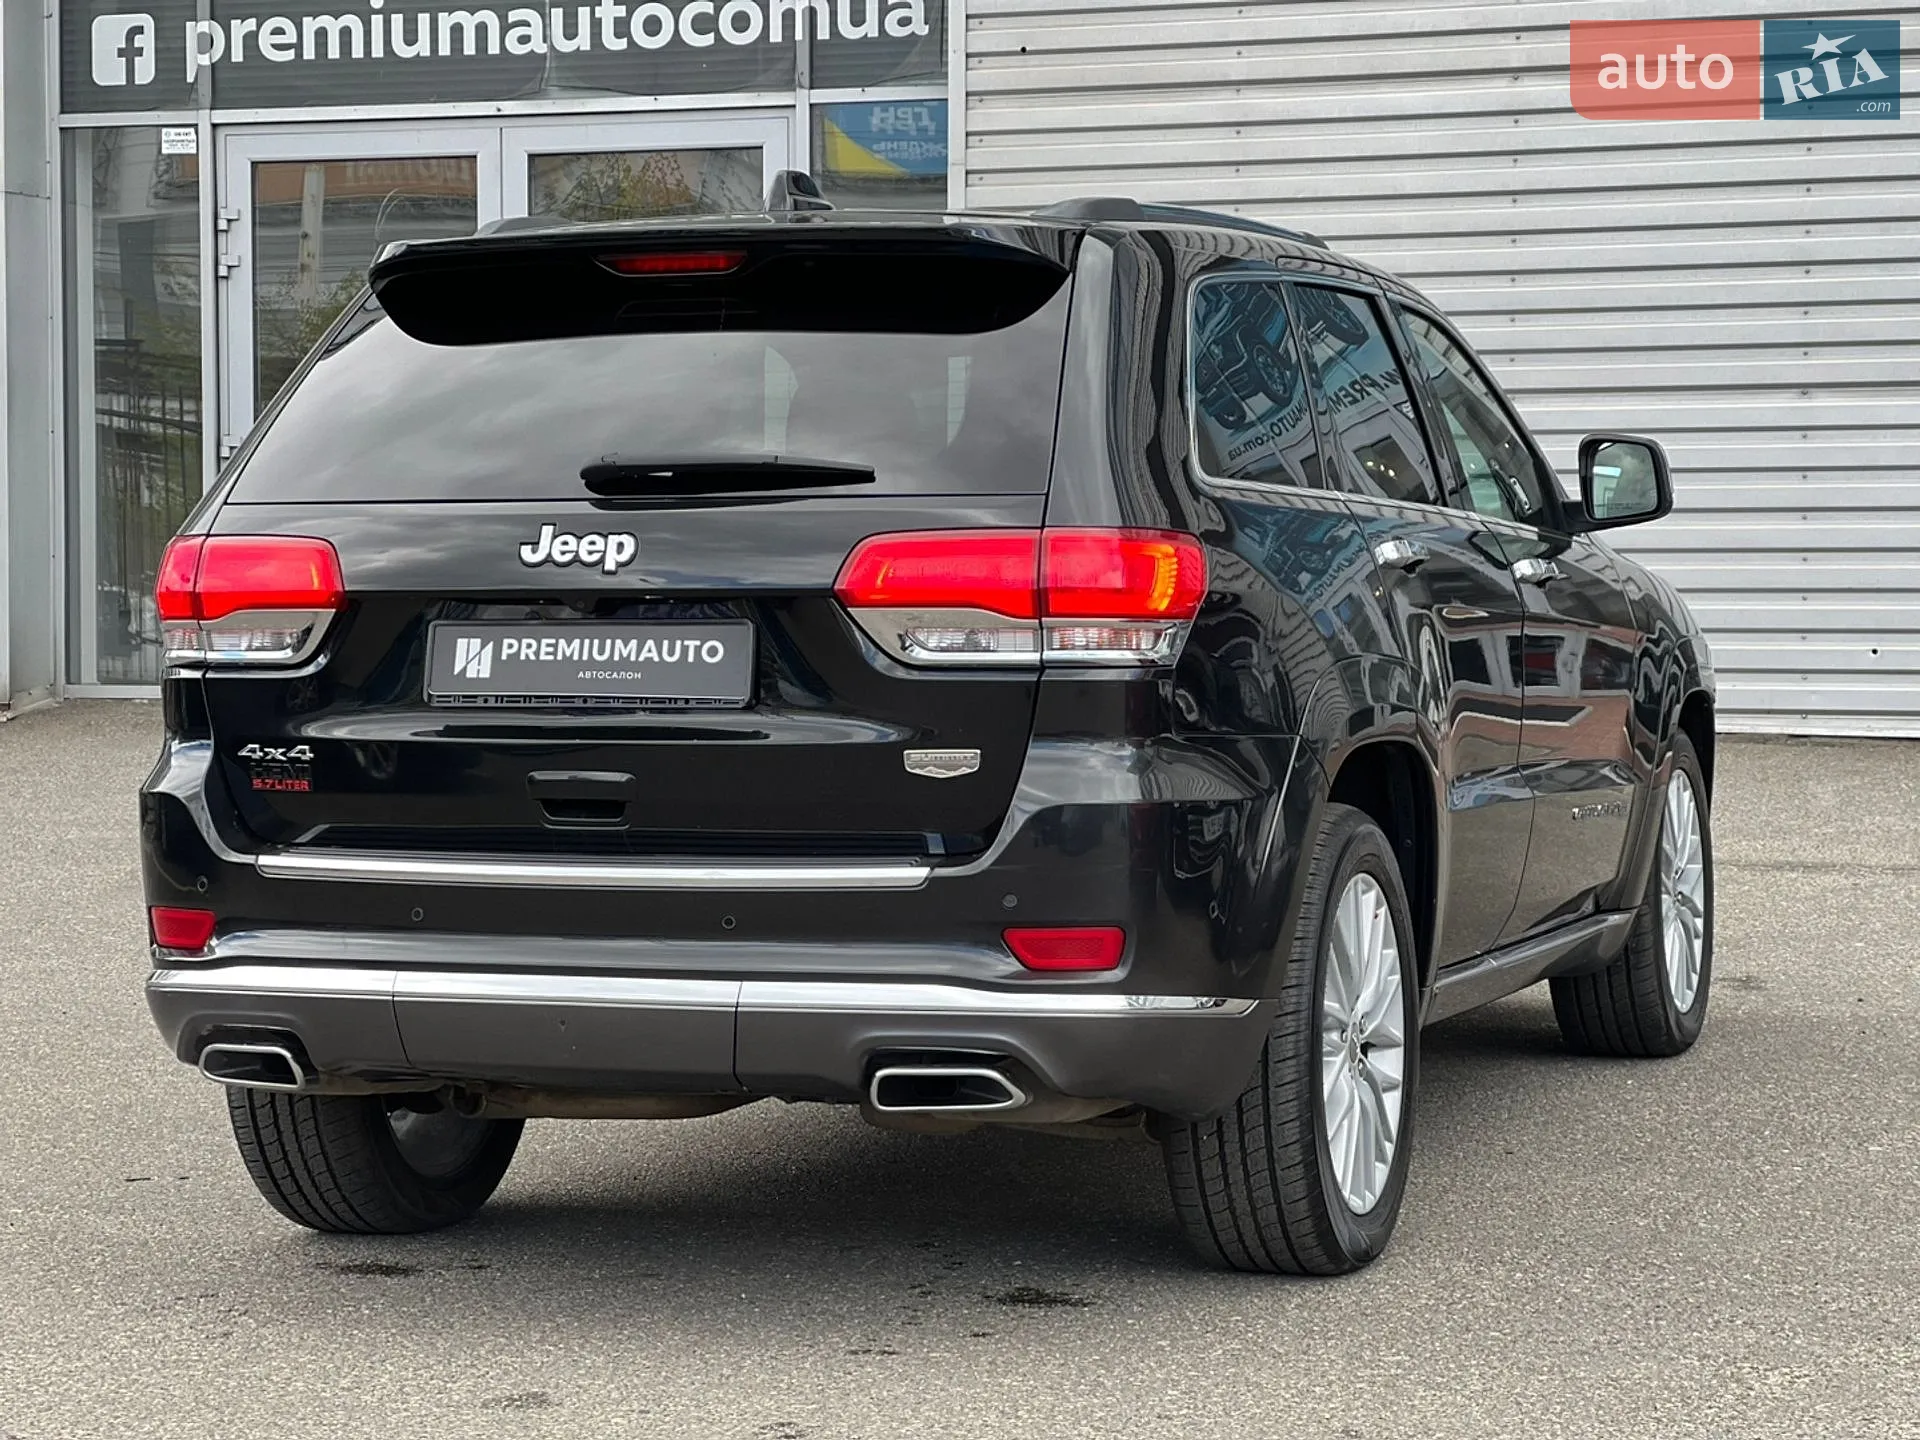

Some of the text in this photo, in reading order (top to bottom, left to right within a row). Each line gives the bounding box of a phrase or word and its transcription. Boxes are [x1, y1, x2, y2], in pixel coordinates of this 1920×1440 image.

[519, 523, 638, 574] Jeep
[500, 637, 725, 664] PREMIUMAUTO
[577, 669, 643, 681] АВТОСАЛОН
